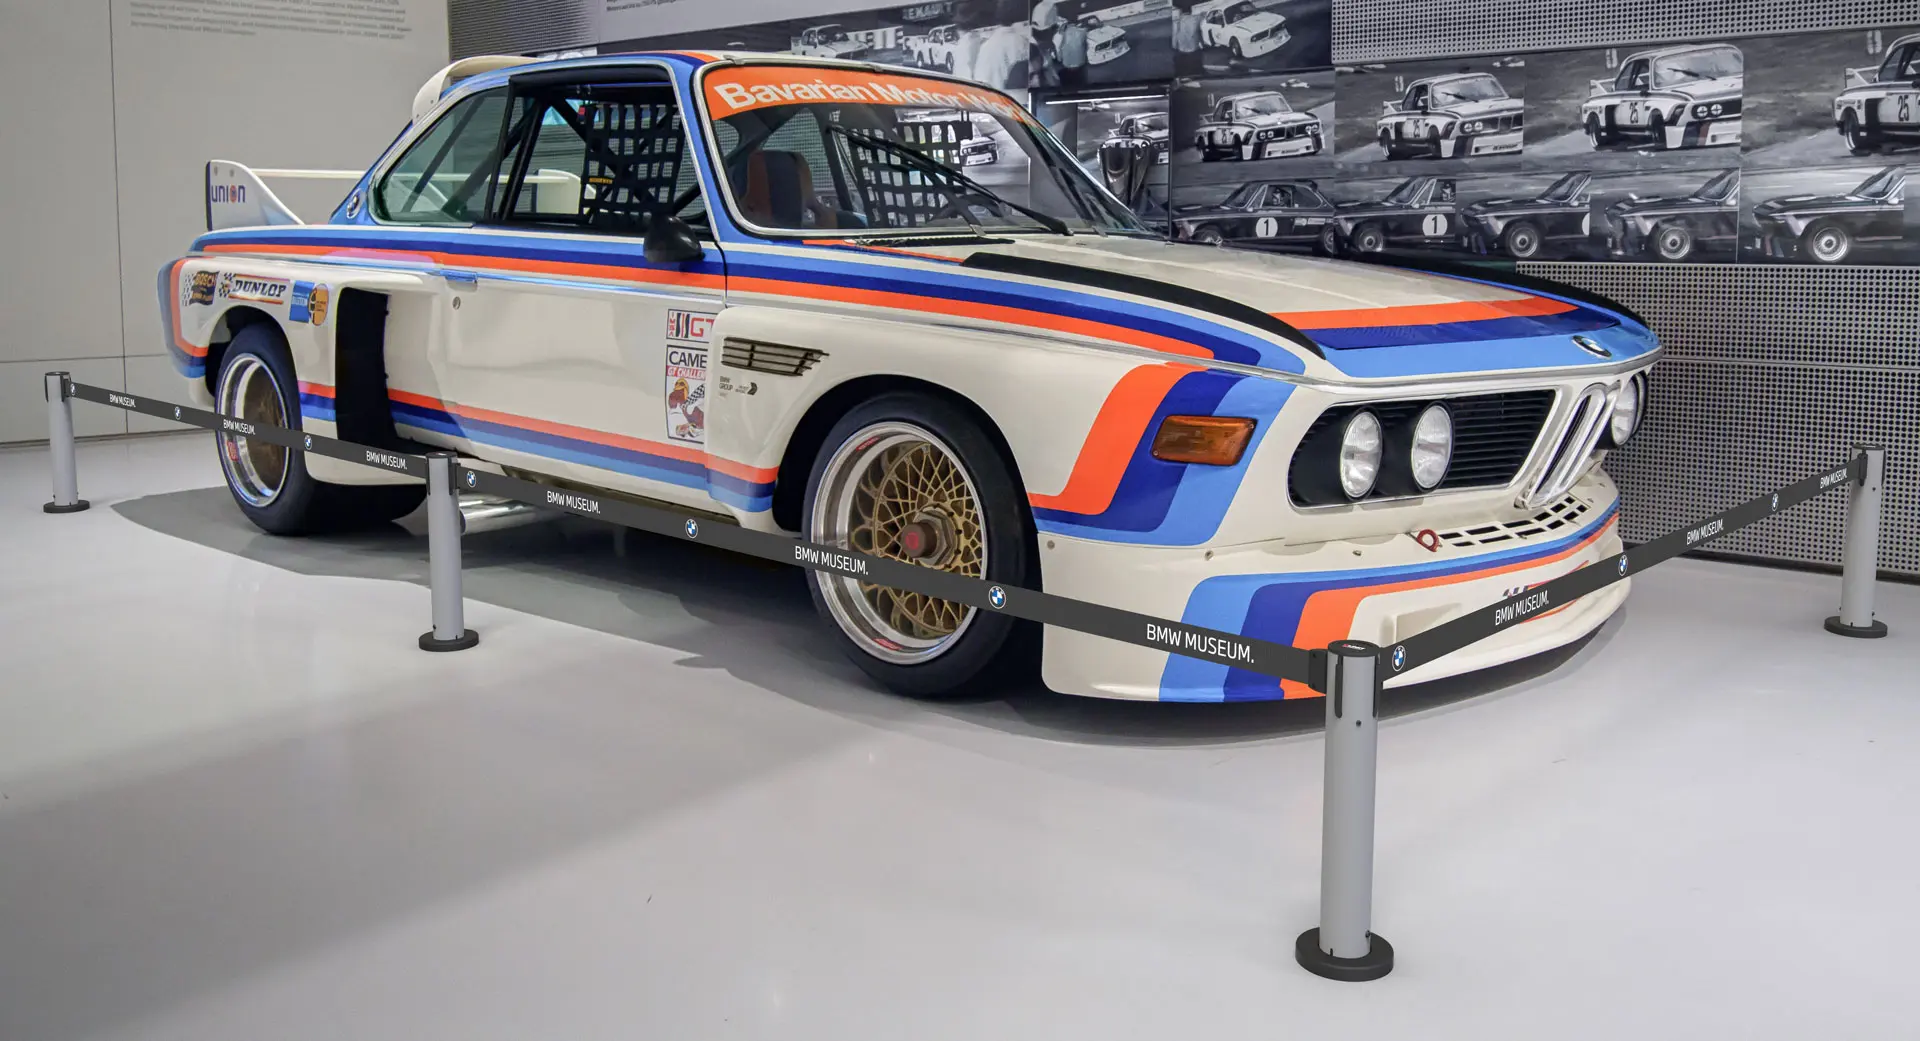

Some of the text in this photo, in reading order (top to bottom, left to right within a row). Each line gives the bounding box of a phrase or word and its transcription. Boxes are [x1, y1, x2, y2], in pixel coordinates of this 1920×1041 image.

[713, 79, 879, 109] Bavarian
[868, 82, 964, 106] Motor
[1629, 102, 1639, 123] 25
[1898, 95, 1909, 121] 25
[211, 184, 246, 203] union
[1263, 218, 1269, 236] 1
[1432, 215, 1438, 234] 1
[232, 279, 287, 297] DUNLOP
[223, 419, 235, 430] BMW
[366, 450, 408, 470] BMW MUSEUM.
[546, 490, 601, 514] BMW MUSEUM.
[1687, 527, 1700, 546] BMW
[795, 545, 869, 576] BMW MUSEUM.
[1495, 590, 1550, 626] BMW MUSEUM.
[1146, 623, 1255, 664] BMW MUSEUM.
